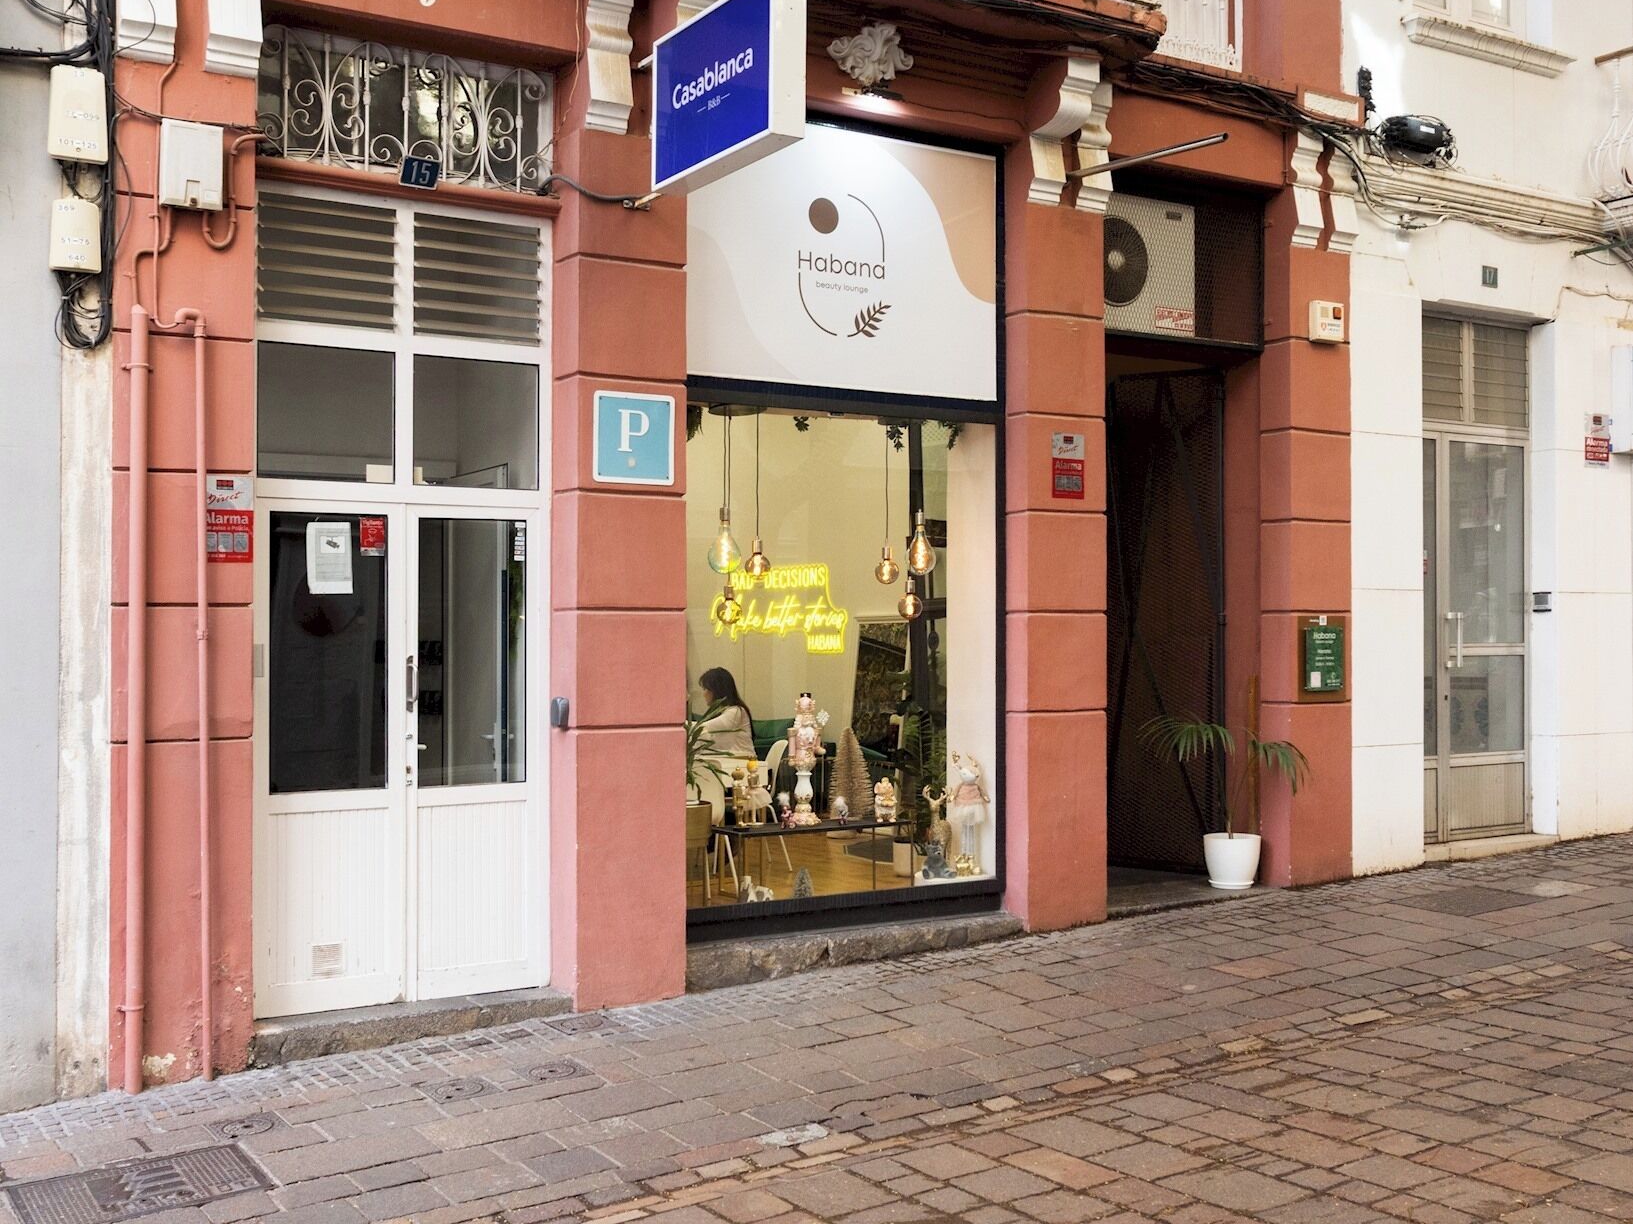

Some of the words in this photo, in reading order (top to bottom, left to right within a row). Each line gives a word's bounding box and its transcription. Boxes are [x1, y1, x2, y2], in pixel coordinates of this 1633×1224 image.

[672, 47, 754, 109] Casablanca
[707, 95, 721, 111] B&B
[410, 160, 432, 185] 15
[798, 249, 886, 280] Habana
[815, 280, 842, 291] beauty
[843, 282, 869, 294] lounge
[617, 408, 650, 452] P
[1056, 460, 1082, 471] Alarma
[764, 567, 826, 589] DECISIONS
[763, 595, 804, 637] better
[807, 634, 842, 651] HABANA
[1313, 631, 1337, 639] Habana
